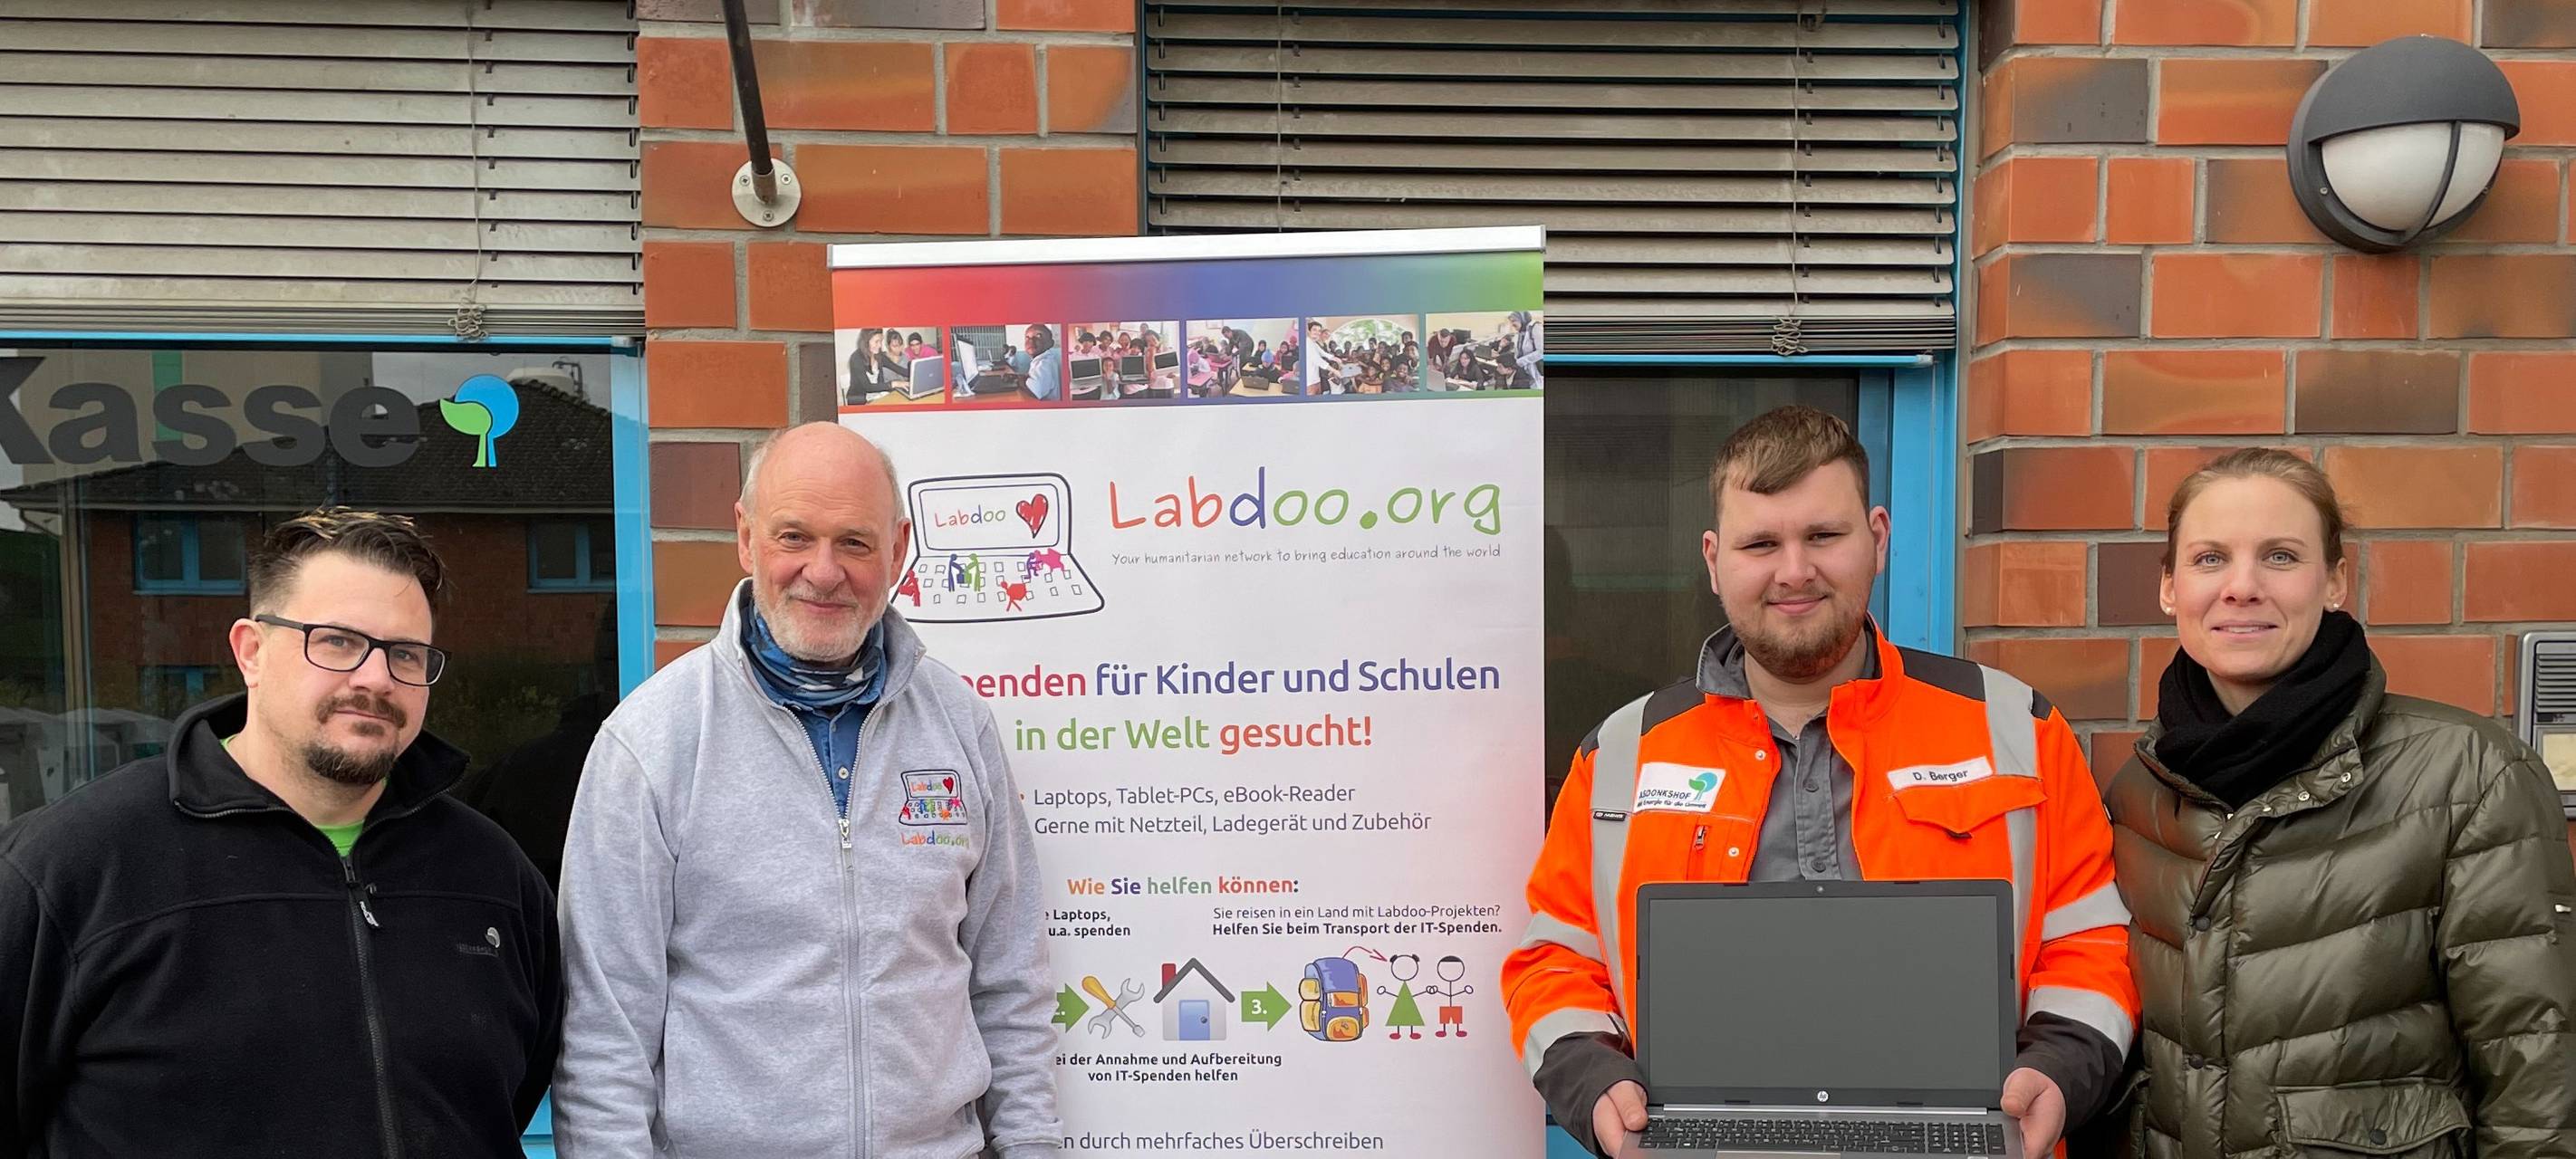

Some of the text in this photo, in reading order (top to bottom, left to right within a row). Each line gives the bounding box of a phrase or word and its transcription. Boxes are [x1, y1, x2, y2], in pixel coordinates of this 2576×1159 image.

[1110, 466, 1501, 535] Labdoo.org
[935, 504, 1005, 528] Labdoo
[1111, 544, 1501, 565] Your humanitarian network to bring education around the world
[961, 657, 1500, 697] enden für Kinder und Schulen
[1015, 714, 1372, 755] in der Welt gesucht!
[1929, 770, 1968, 781] Berger
[1034, 784, 1356, 808] Laptops, Tablet-PCs, eBook-Reader
[1034, 812, 1432, 836] Gerne mit Netzteil, Ladegerät und Zubehör
[1067, 876, 1299, 895] Wie Sie helfen können:
[1053, 909, 1110, 923] Laptops,
[1213, 905, 1501, 920] Sie reisen in ein Land mit Labdoo-Projekten?
[1048, 925, 1131, 939] u.a. spenden
[1213, 920, 1503, 937] Helfen Sie beim Transport der IT-Spenden.
[1251, 999, 1268, 1014] 3.
[1055, 1051, 1283, 1067] ei der Annahme und Aufbereitung
[1088, 1068, 1238, 1084] von IT-Spenden helfen
[1080, 1132, 1130, 1149] durch
[1136, 1131, 1244, 1149] mehrfaches
[1249, 1129, 1383, 1149] Überschreiben
